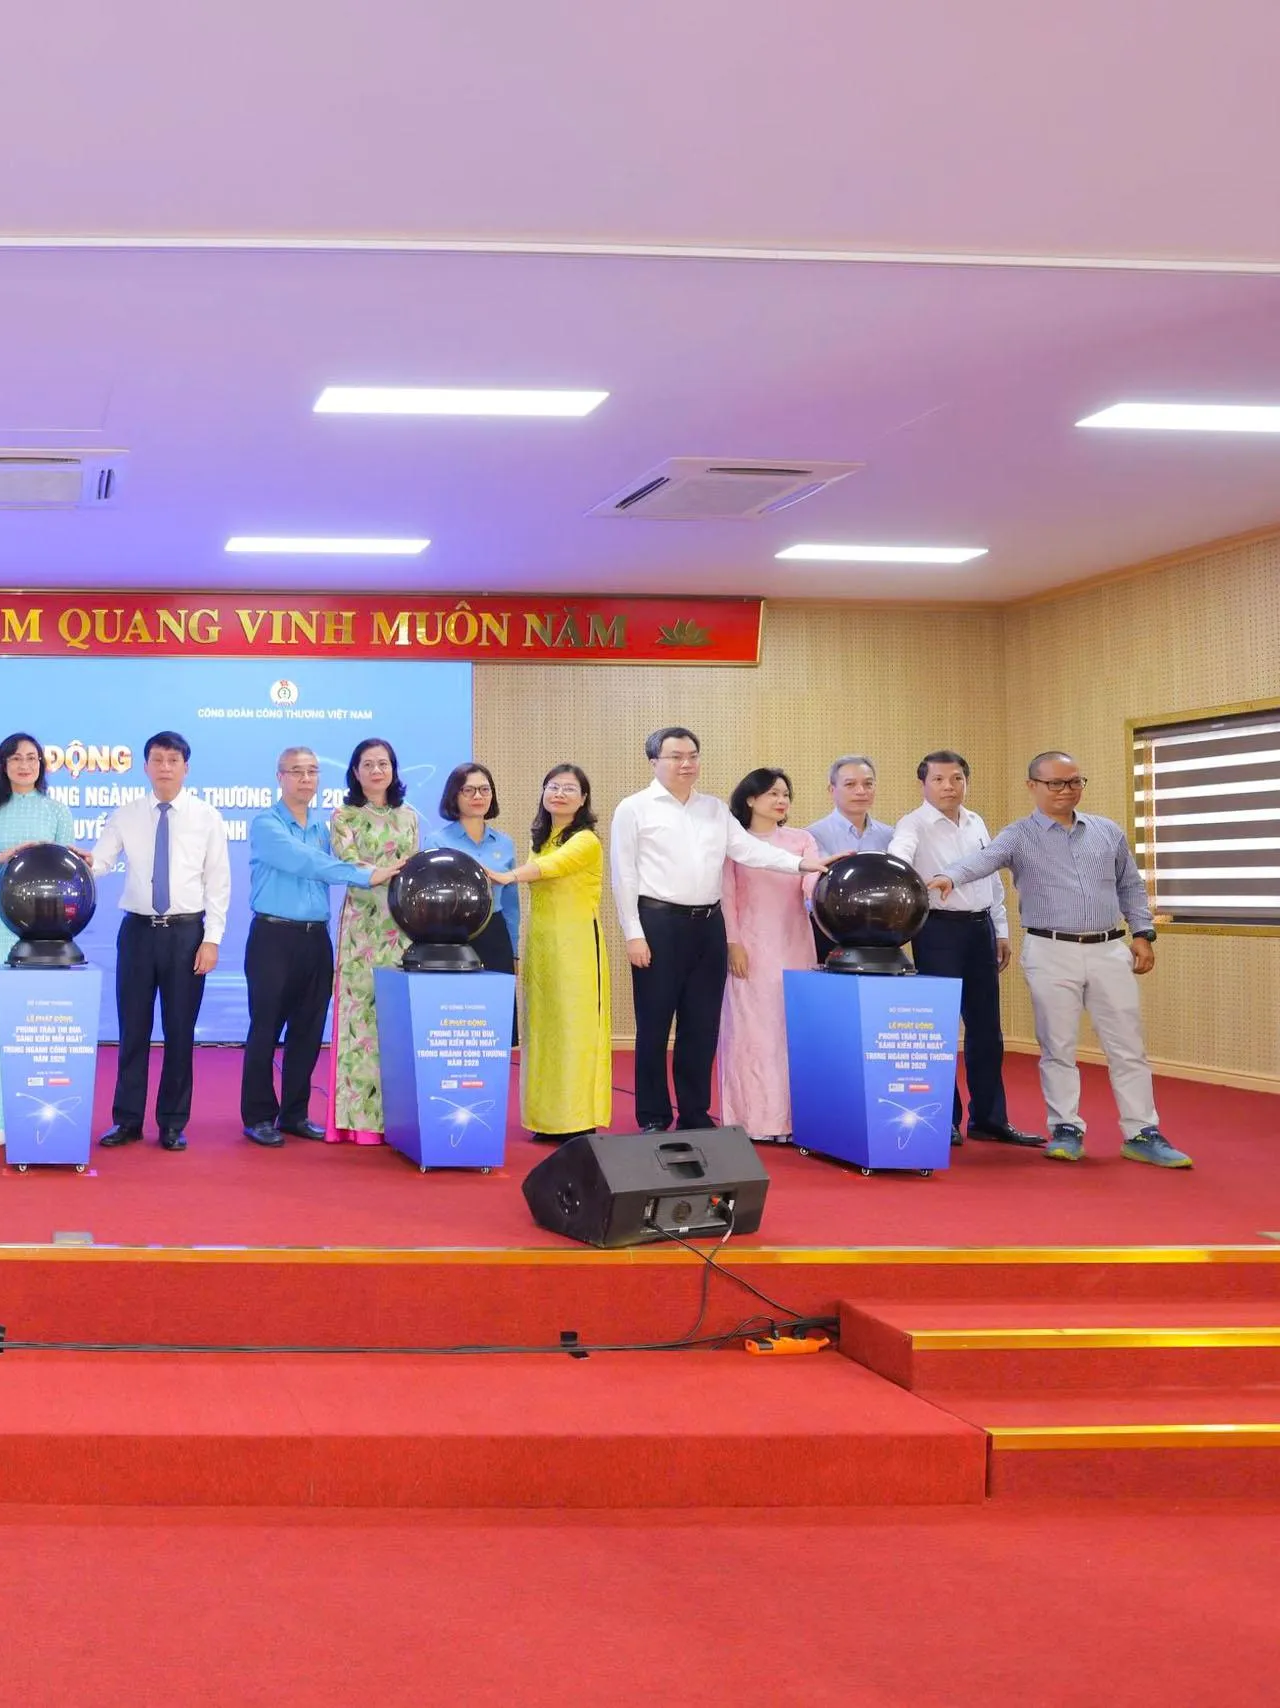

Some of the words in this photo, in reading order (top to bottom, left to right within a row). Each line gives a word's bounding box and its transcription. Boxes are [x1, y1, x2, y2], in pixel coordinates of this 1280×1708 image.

[57, 608, 222, 650] QUANG
[236, 608, 356, 645] VINH
[370, 600, 510, 648] MUÔN
[522, 605, 628, 650] NĂM
[197, 708, 224, 719] CÔNG
[350, 711, 373, 720] NAM
[44, 739, 132, 778] ĐỘNG
[85, 782, 146, 807] NGÀNH
[203, 785, 272, 808] THƯƠNG
